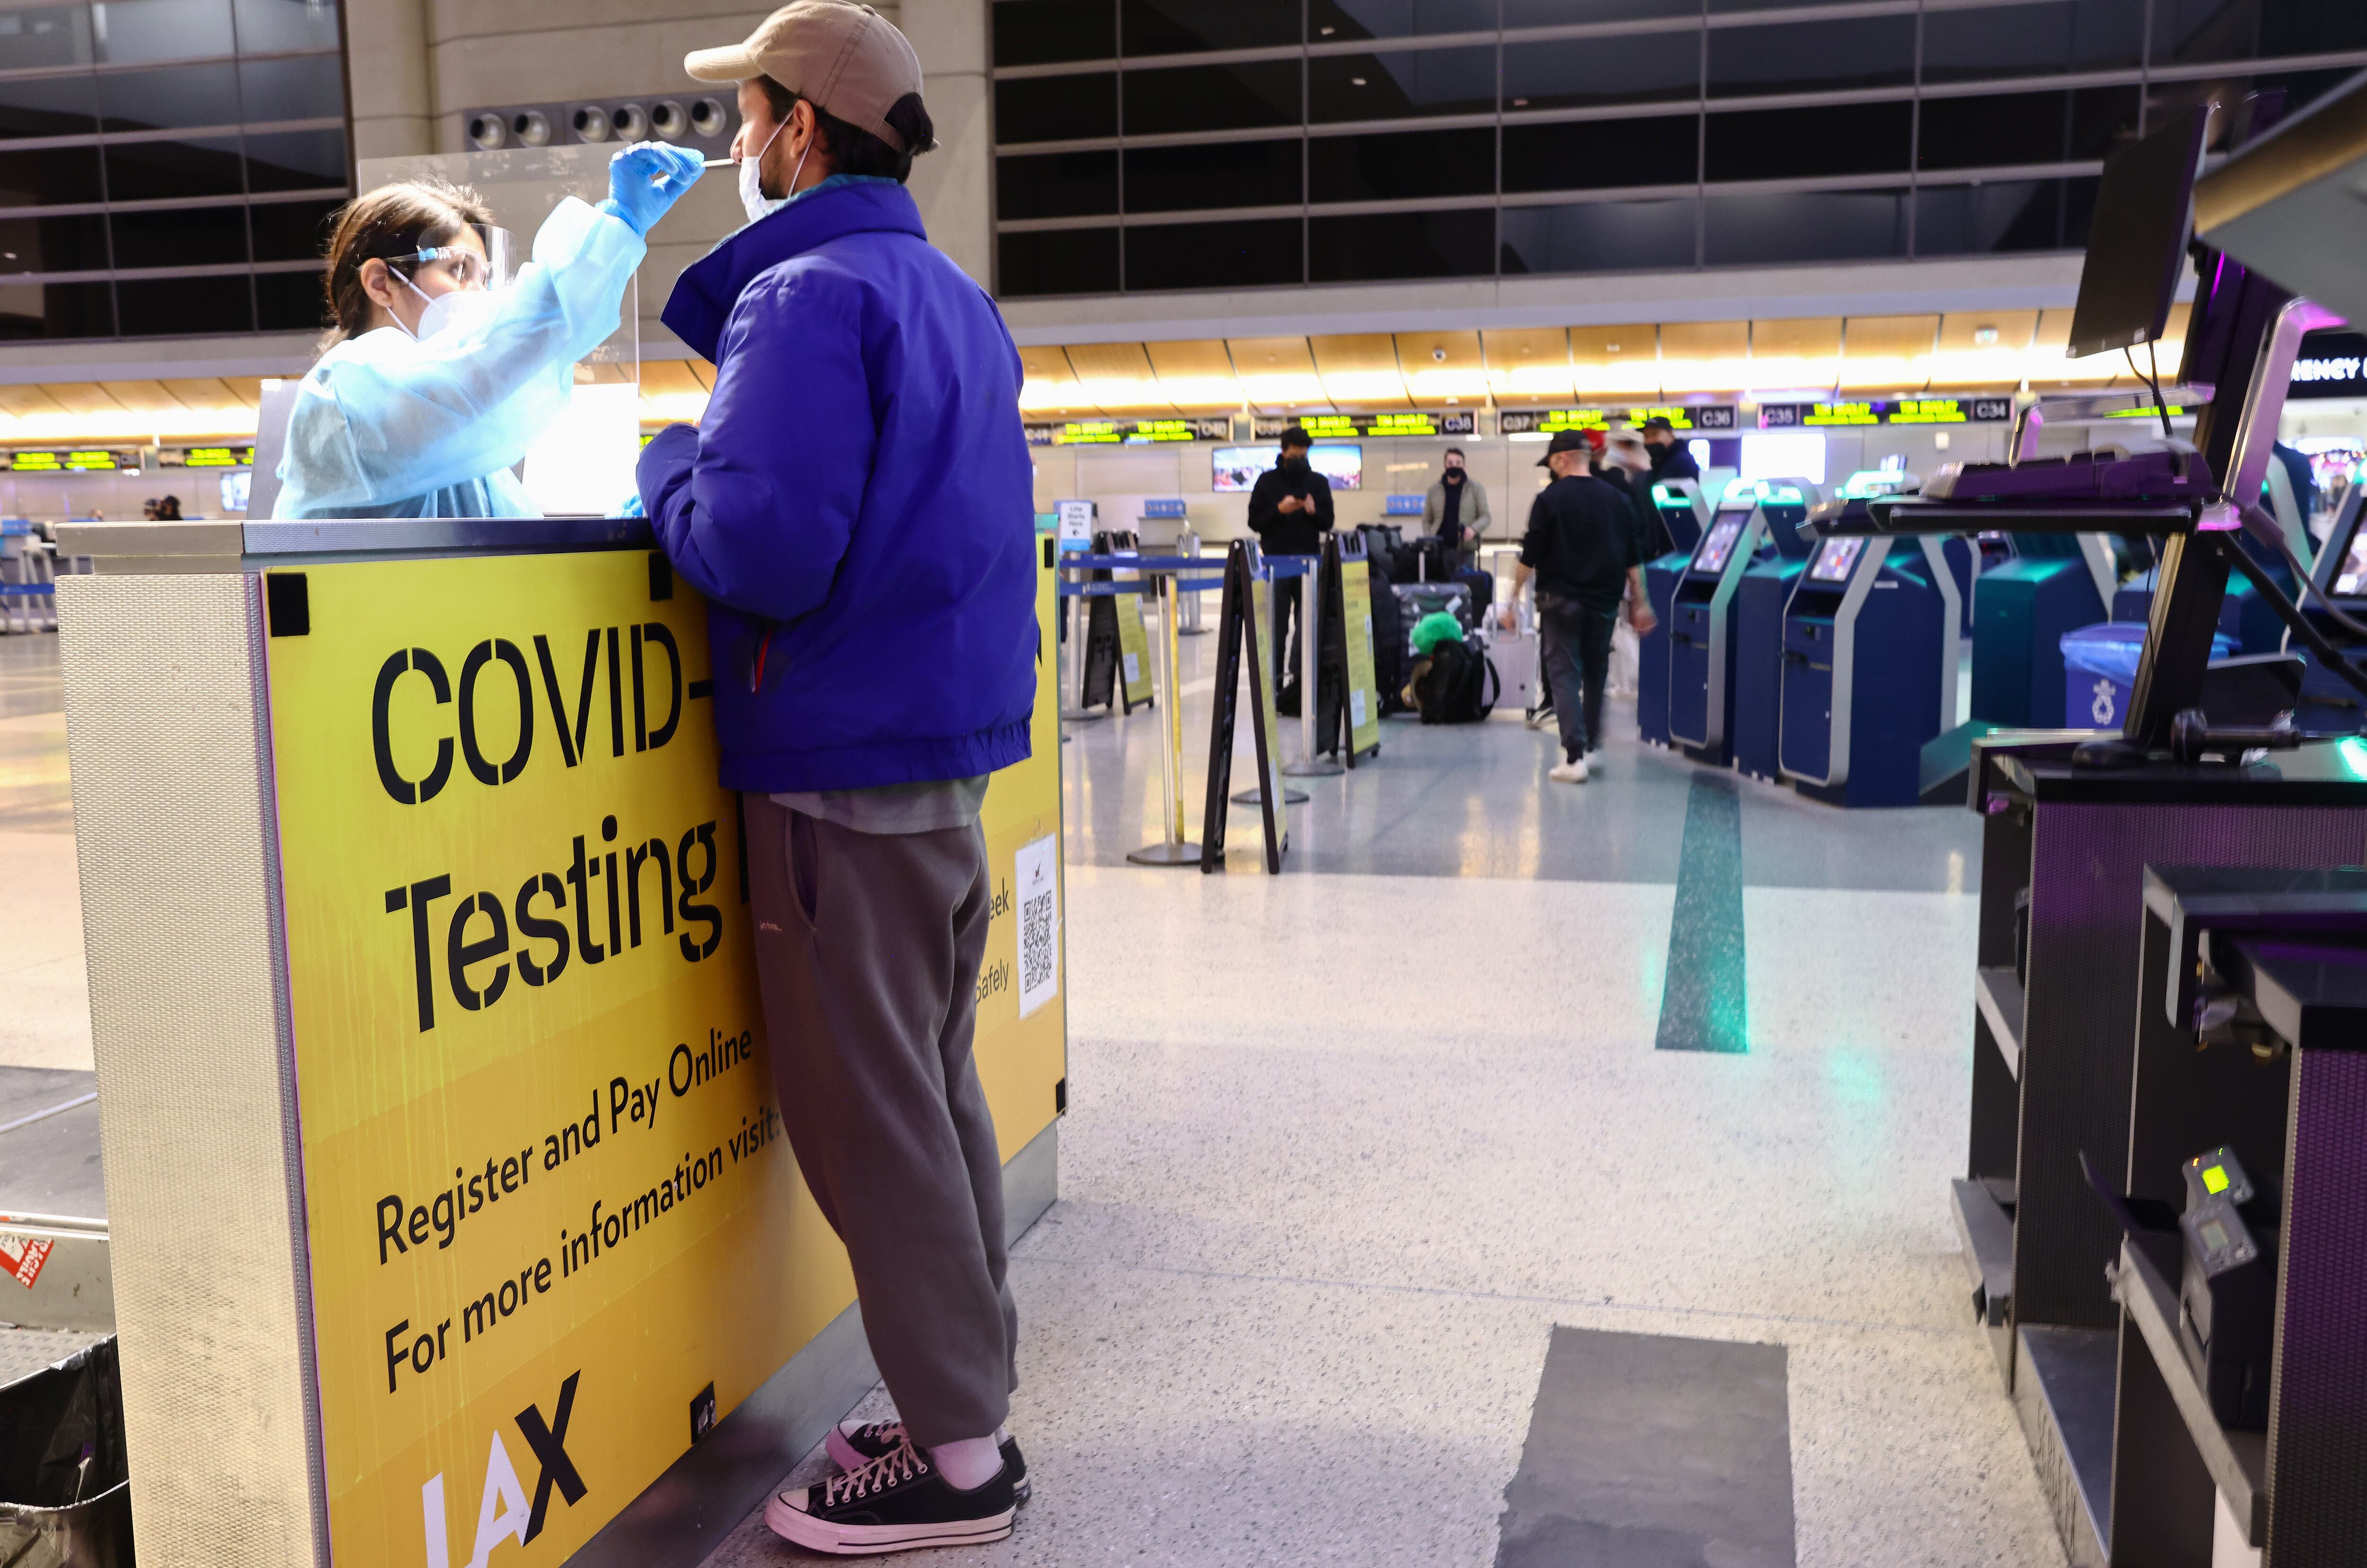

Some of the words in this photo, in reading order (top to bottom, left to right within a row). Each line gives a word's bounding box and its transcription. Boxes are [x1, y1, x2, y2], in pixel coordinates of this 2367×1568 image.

[373, 622, 713, 805] COVID-
[385, 814, 723, 1033] Testing
[377, 1145, 533, 1266] Register
[544, 1089, 600, 1171] and
[610, 1076, 661, 1134] Pay
[669, 1027, 752, 1097] Online
[386, 1317, 451, 1394] For
[463, 1257, 552, 1343] more
[561, 1146, 723, 1278] information
[729, 1105, 781, 1164] visit:
